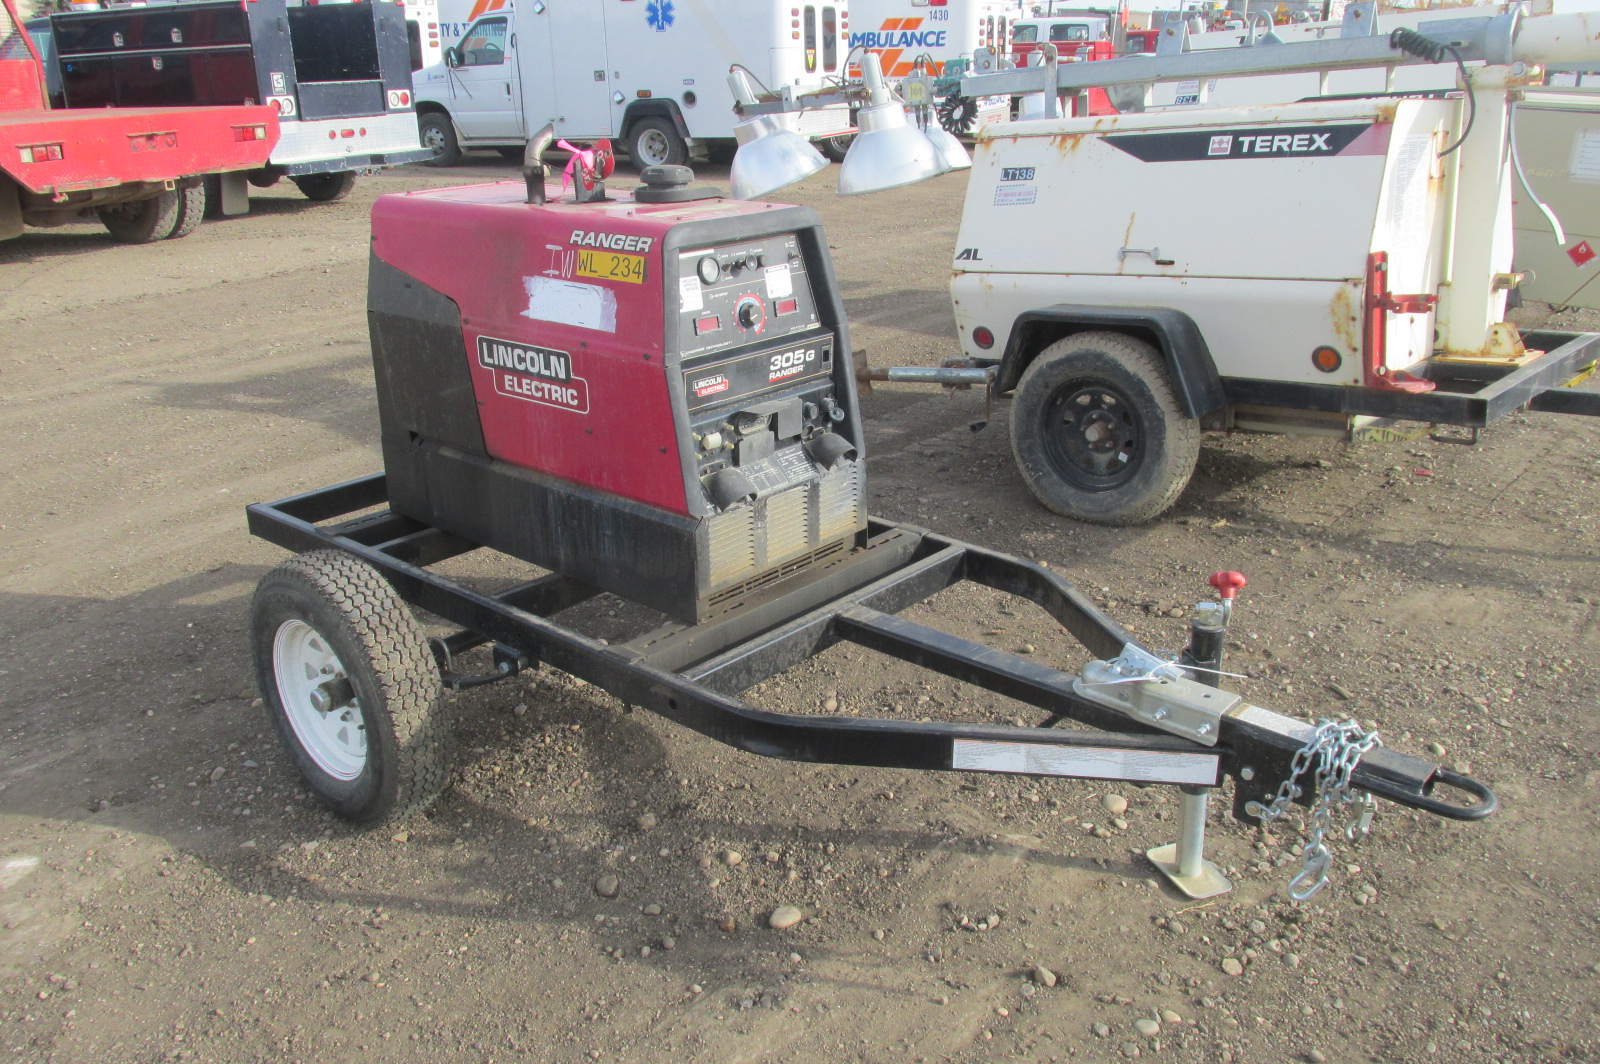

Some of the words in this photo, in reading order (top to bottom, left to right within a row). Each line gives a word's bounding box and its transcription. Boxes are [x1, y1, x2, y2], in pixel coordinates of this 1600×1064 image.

[929, 10, 949, 21] 1430
[453, 23, 460, 37] &
[1238, 133, 1332, 153] TEREX
[1000, 168, 1034, 181] LT138
[569, 229, 653, 253] RANGER
[955, 248, 983, 261] AL
[482, 341, 566, 379] LINCOLN
[768, 365, 804, 380] RANGER
[504, 374, 579, 406] ELECTRIC
[694, 375, 722, 390] LINCOLN
[701, 384, 726, 395] ELECTRIC
